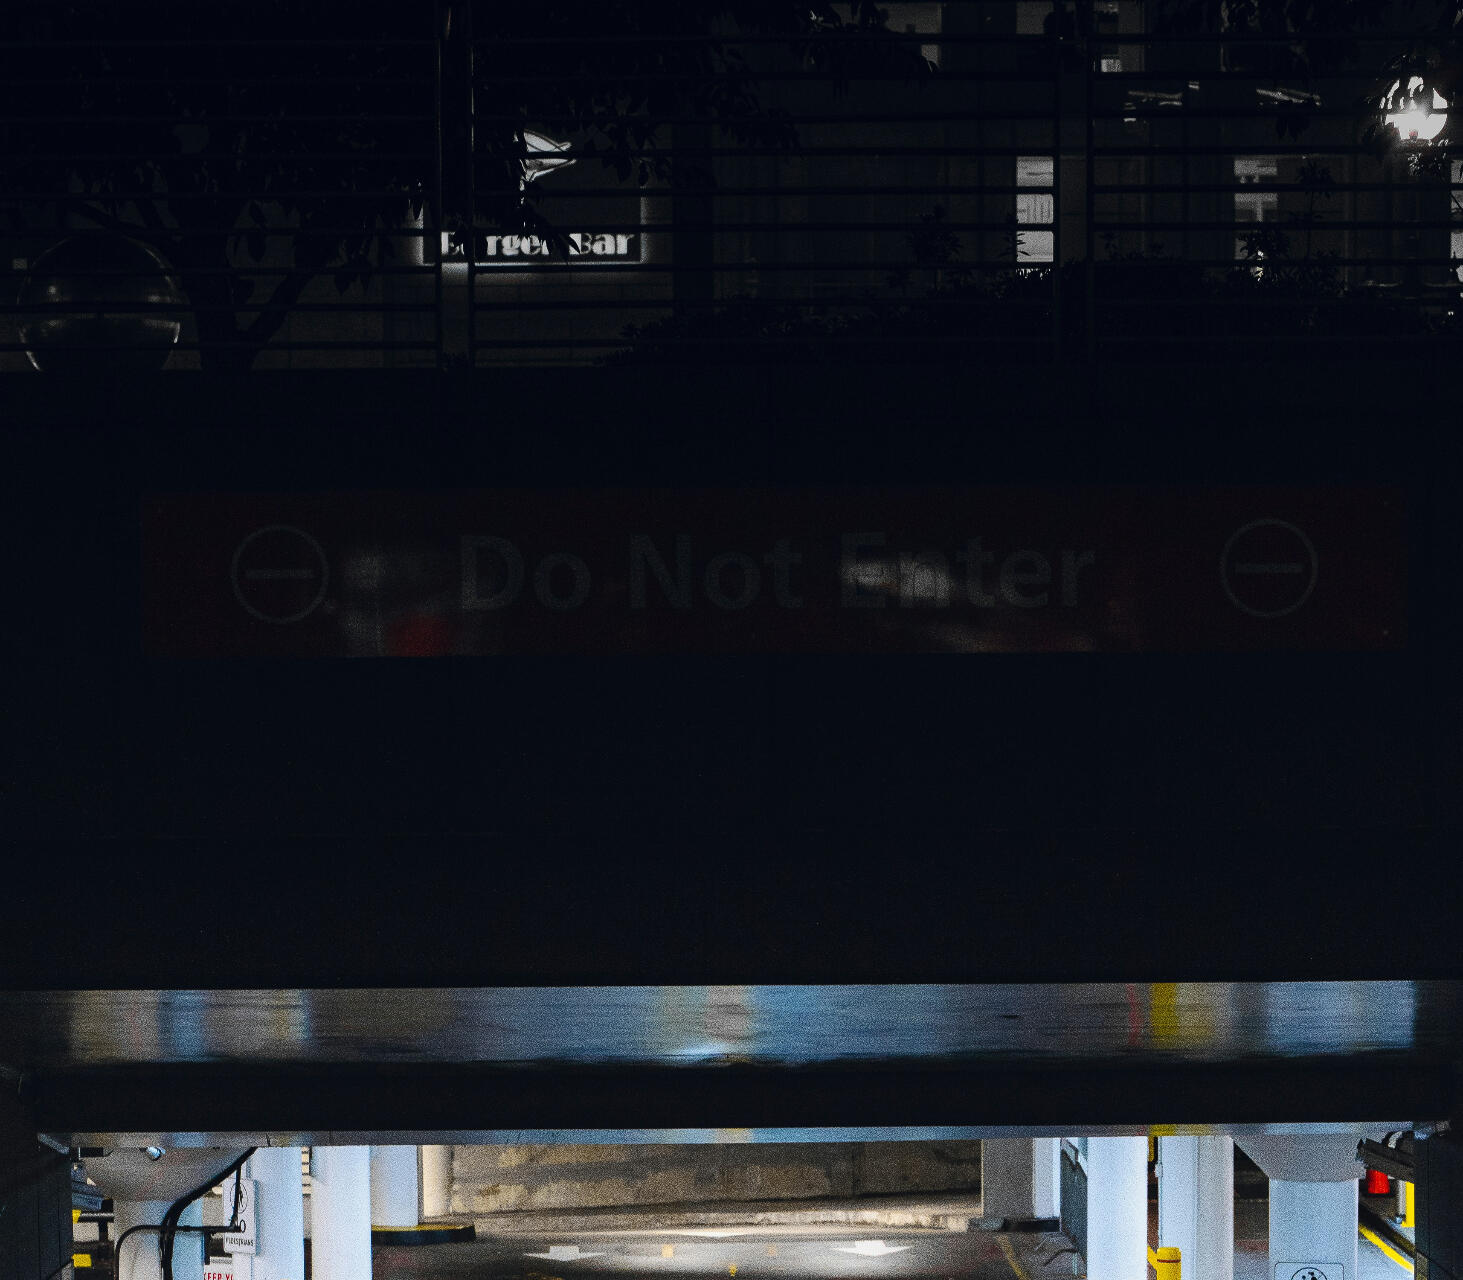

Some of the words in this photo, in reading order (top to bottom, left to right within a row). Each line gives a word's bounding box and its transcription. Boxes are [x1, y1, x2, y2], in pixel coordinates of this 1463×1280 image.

[569, 232, 634, 256] Bar
[460, 535, 593, 610] Do
[628, 534, 806, 610] Not
[840, 531, 1095, 609] Enter
